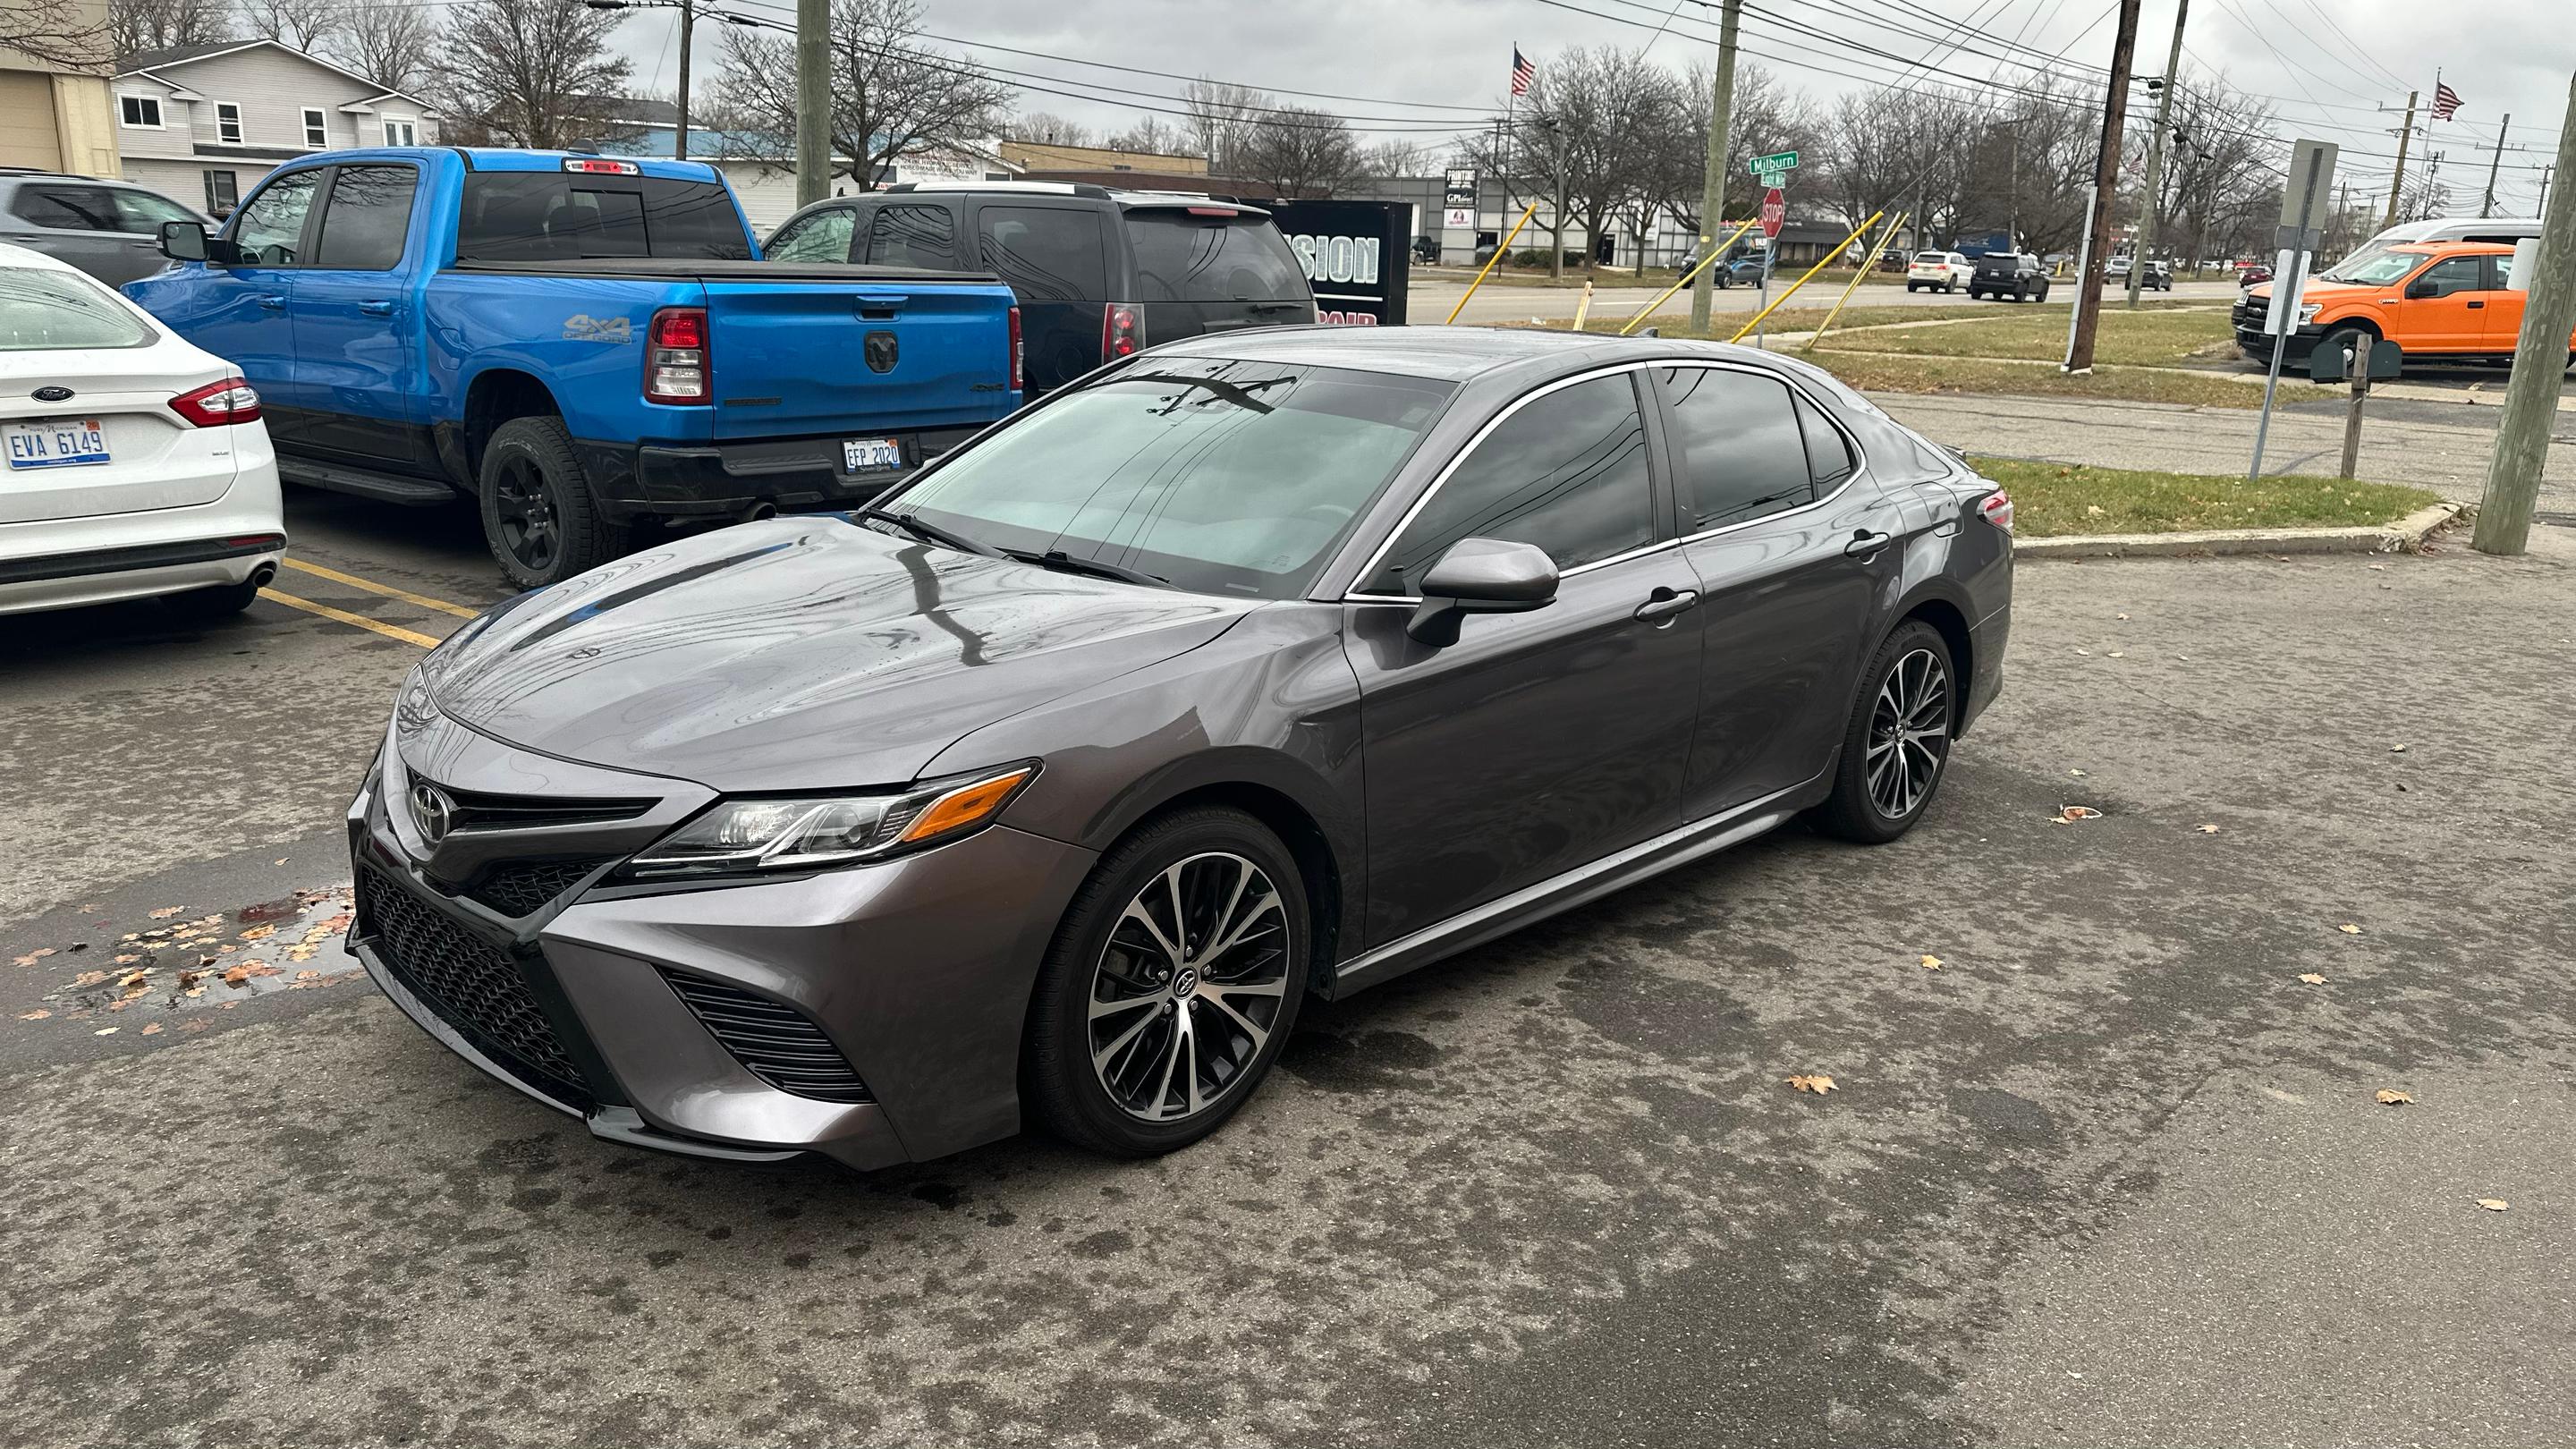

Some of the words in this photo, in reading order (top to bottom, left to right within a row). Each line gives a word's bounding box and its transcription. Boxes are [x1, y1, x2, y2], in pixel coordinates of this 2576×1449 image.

[1754, 157, 1794, 172] Milburn
[1446, 170, 1476, 181] PRINTING
[1764, 204, 1783, 222] STOP
[41, 389, 66, 399] Ford
[11, 435, 47, 457] EVA
[57, 431, 103, 454] 6149
[847, 448, 866, 467] EFP
[872, 446, 898, 464] 2020
